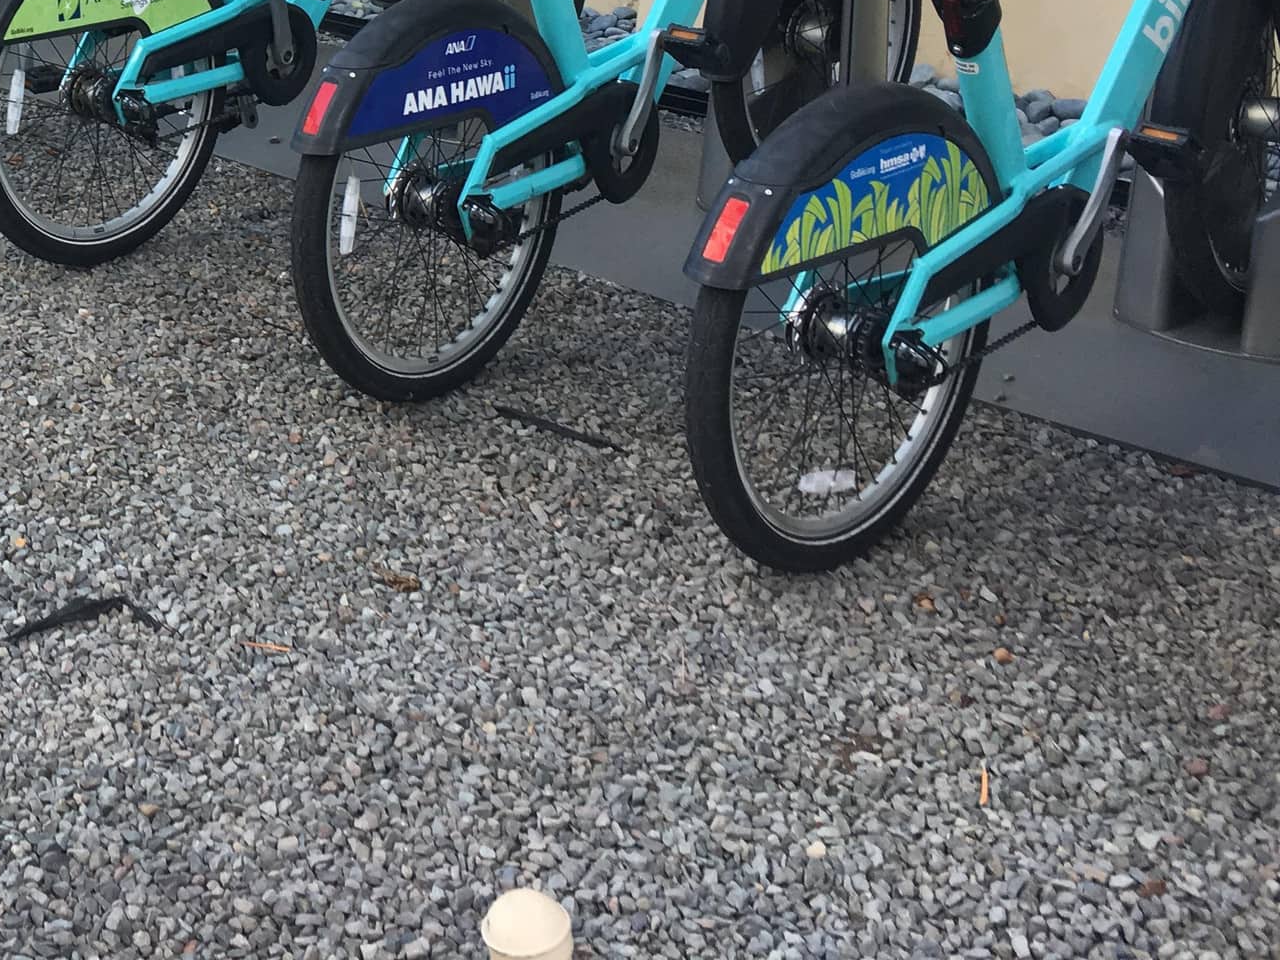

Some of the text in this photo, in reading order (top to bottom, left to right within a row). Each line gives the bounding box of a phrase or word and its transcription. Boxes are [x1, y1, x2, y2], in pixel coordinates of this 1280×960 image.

[445, 42, 467, 55] ANA
[427, 70, 446, 80] Feel
[448, 66, 462, 75] The
[462, 62, 479, 72] New
[402, 85, 448, 116] ANA
[880, 152, 910, 169] hmsa
